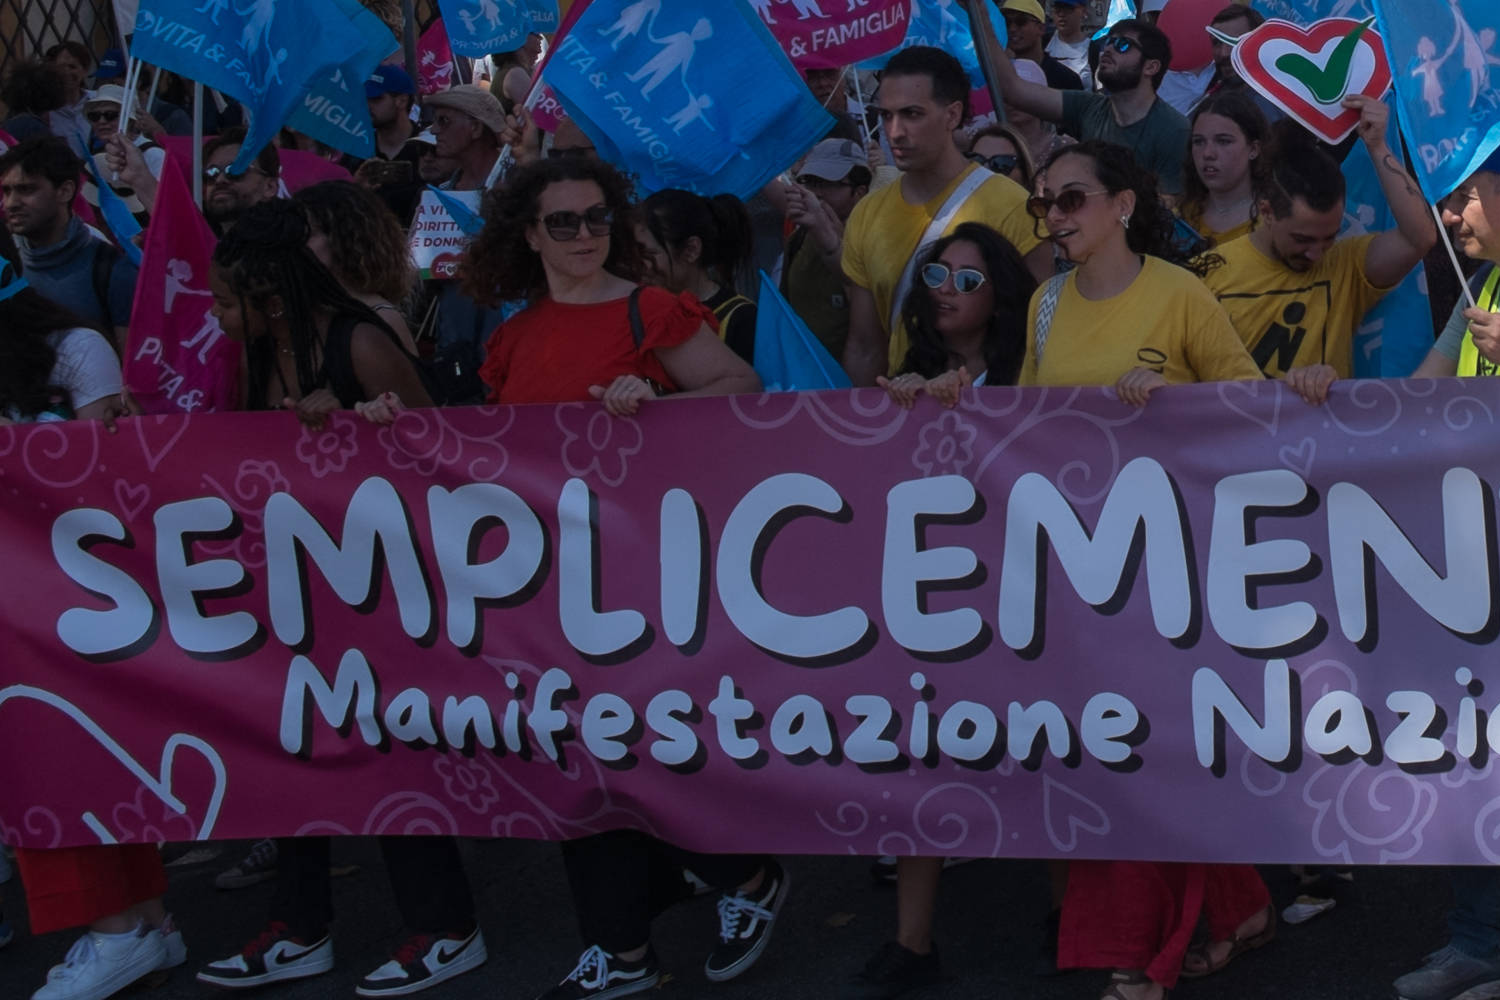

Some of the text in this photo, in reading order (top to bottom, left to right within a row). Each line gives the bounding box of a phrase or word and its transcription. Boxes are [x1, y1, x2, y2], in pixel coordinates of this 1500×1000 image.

[135, 9, 207, 53] OVITA
[790, 2, 905, 57] & FAMIGLIA
[416, 221, 461, 231] DIRITT
[279, 647, 1145, 770] Manifestazione
